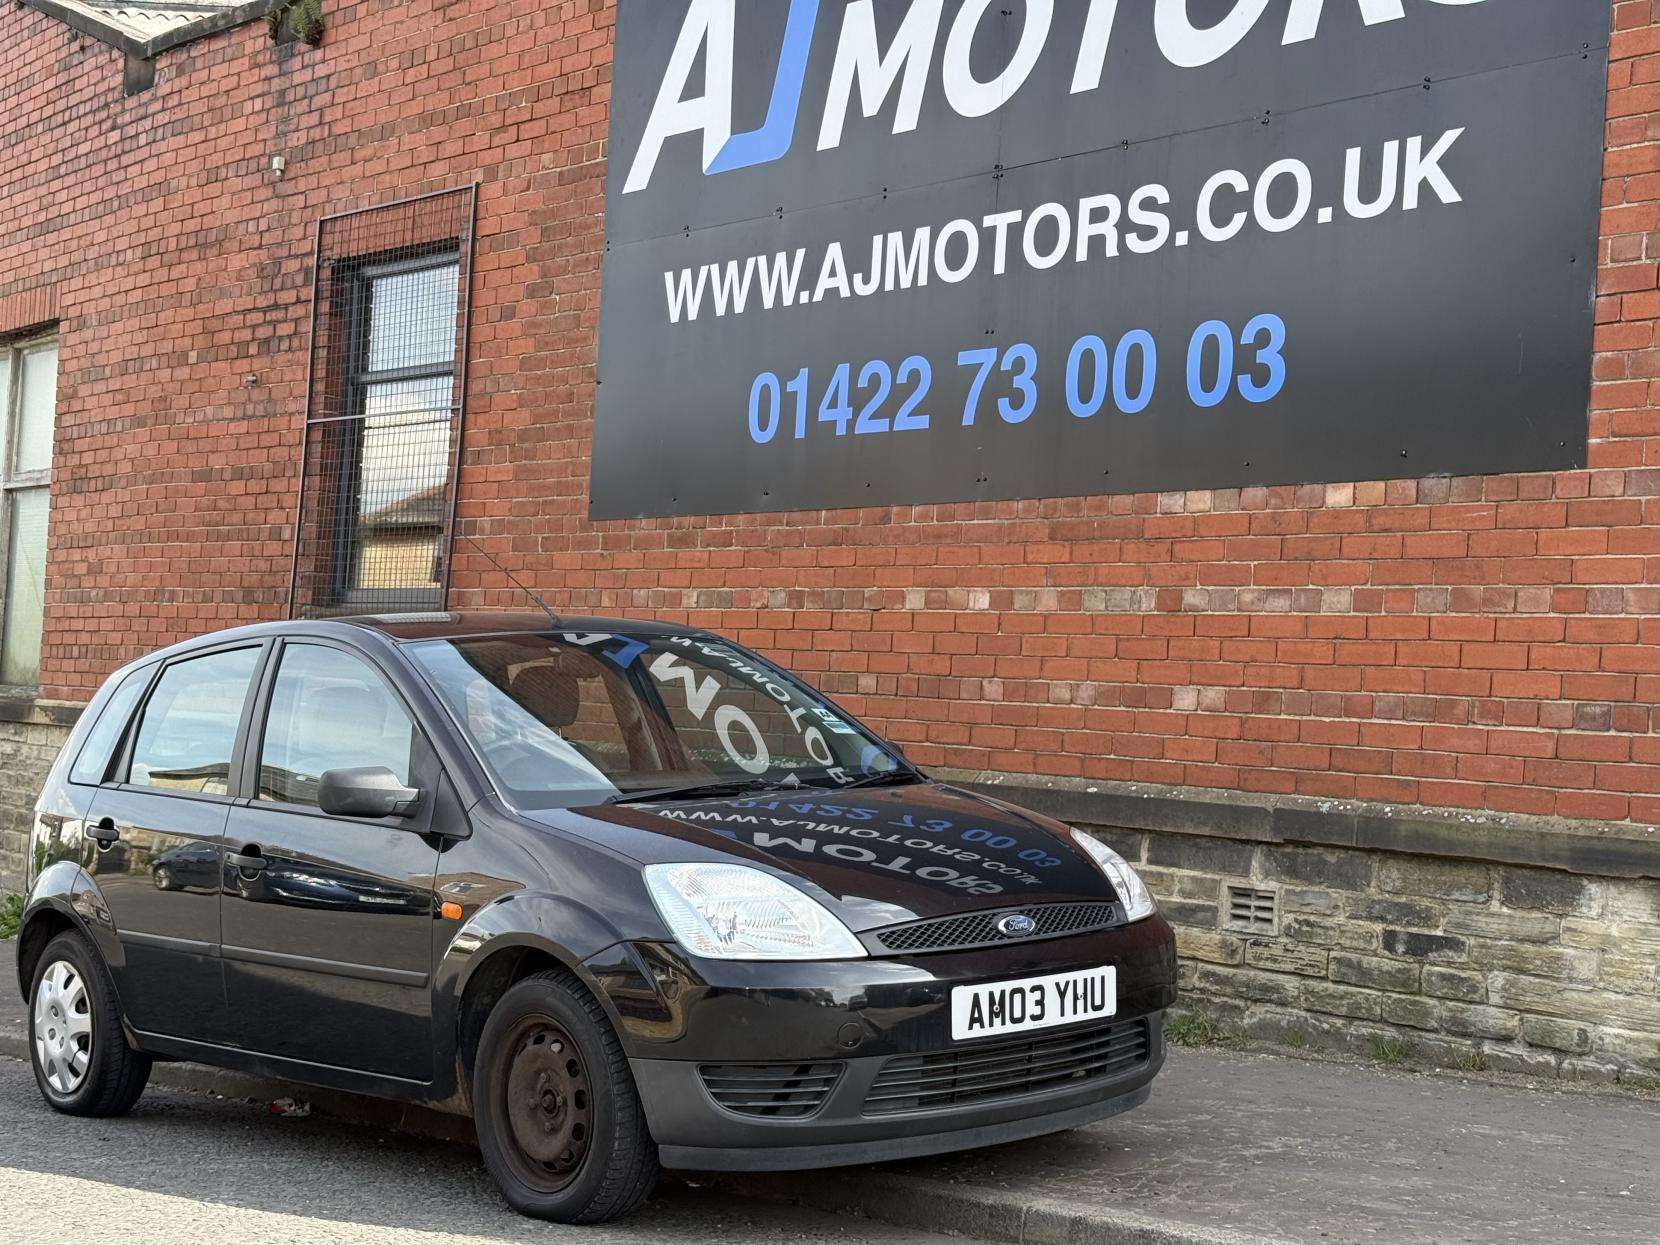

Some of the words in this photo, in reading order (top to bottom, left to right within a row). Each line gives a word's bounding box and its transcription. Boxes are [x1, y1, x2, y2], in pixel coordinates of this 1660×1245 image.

[663, 127, 1466, 324] WWW.AJMOTORS.CO.UK
[748, 355, 932, 444] 01422
[957, 343, 1038, 426] 73
[1065, 329, 1157, 418] 00
[1186, 313, 1286, 408] 03
[1008, 918, 1029, 931] Ford
[968, 984, 1046, 1031] AM03
[1055, 975, 1106, 1018] YHU
